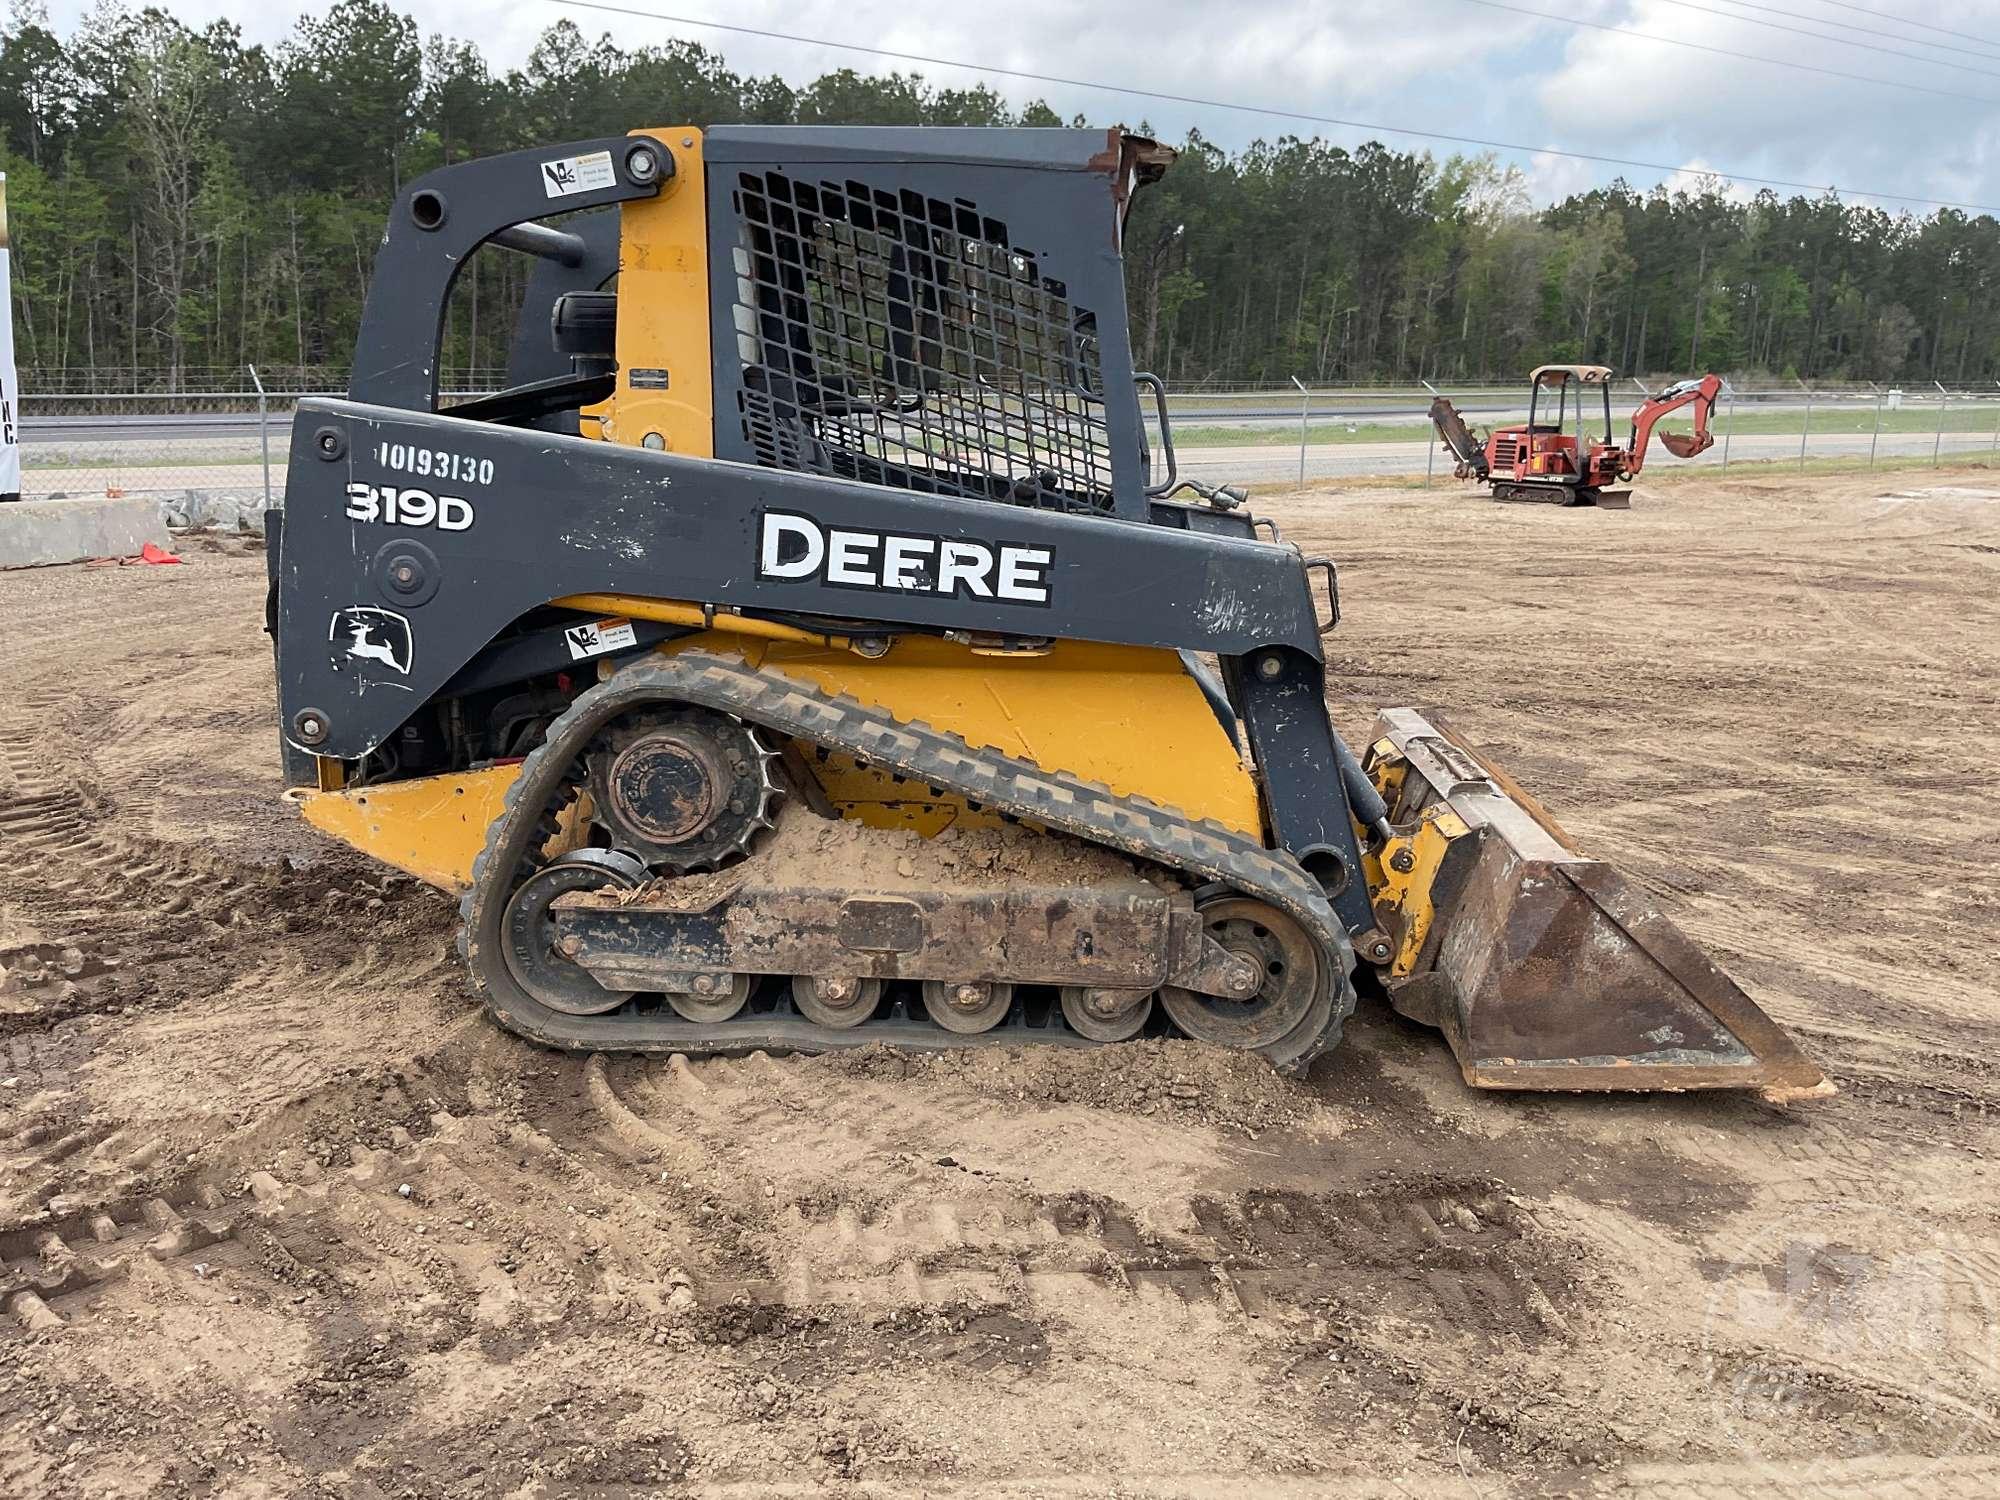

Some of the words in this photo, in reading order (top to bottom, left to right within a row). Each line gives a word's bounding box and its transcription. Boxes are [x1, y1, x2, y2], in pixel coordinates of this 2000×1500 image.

[380, 441, 495, 486] 10193130
[345, 482, 475, 532] 319D
[759, 511, 1052, 603] DEERE
